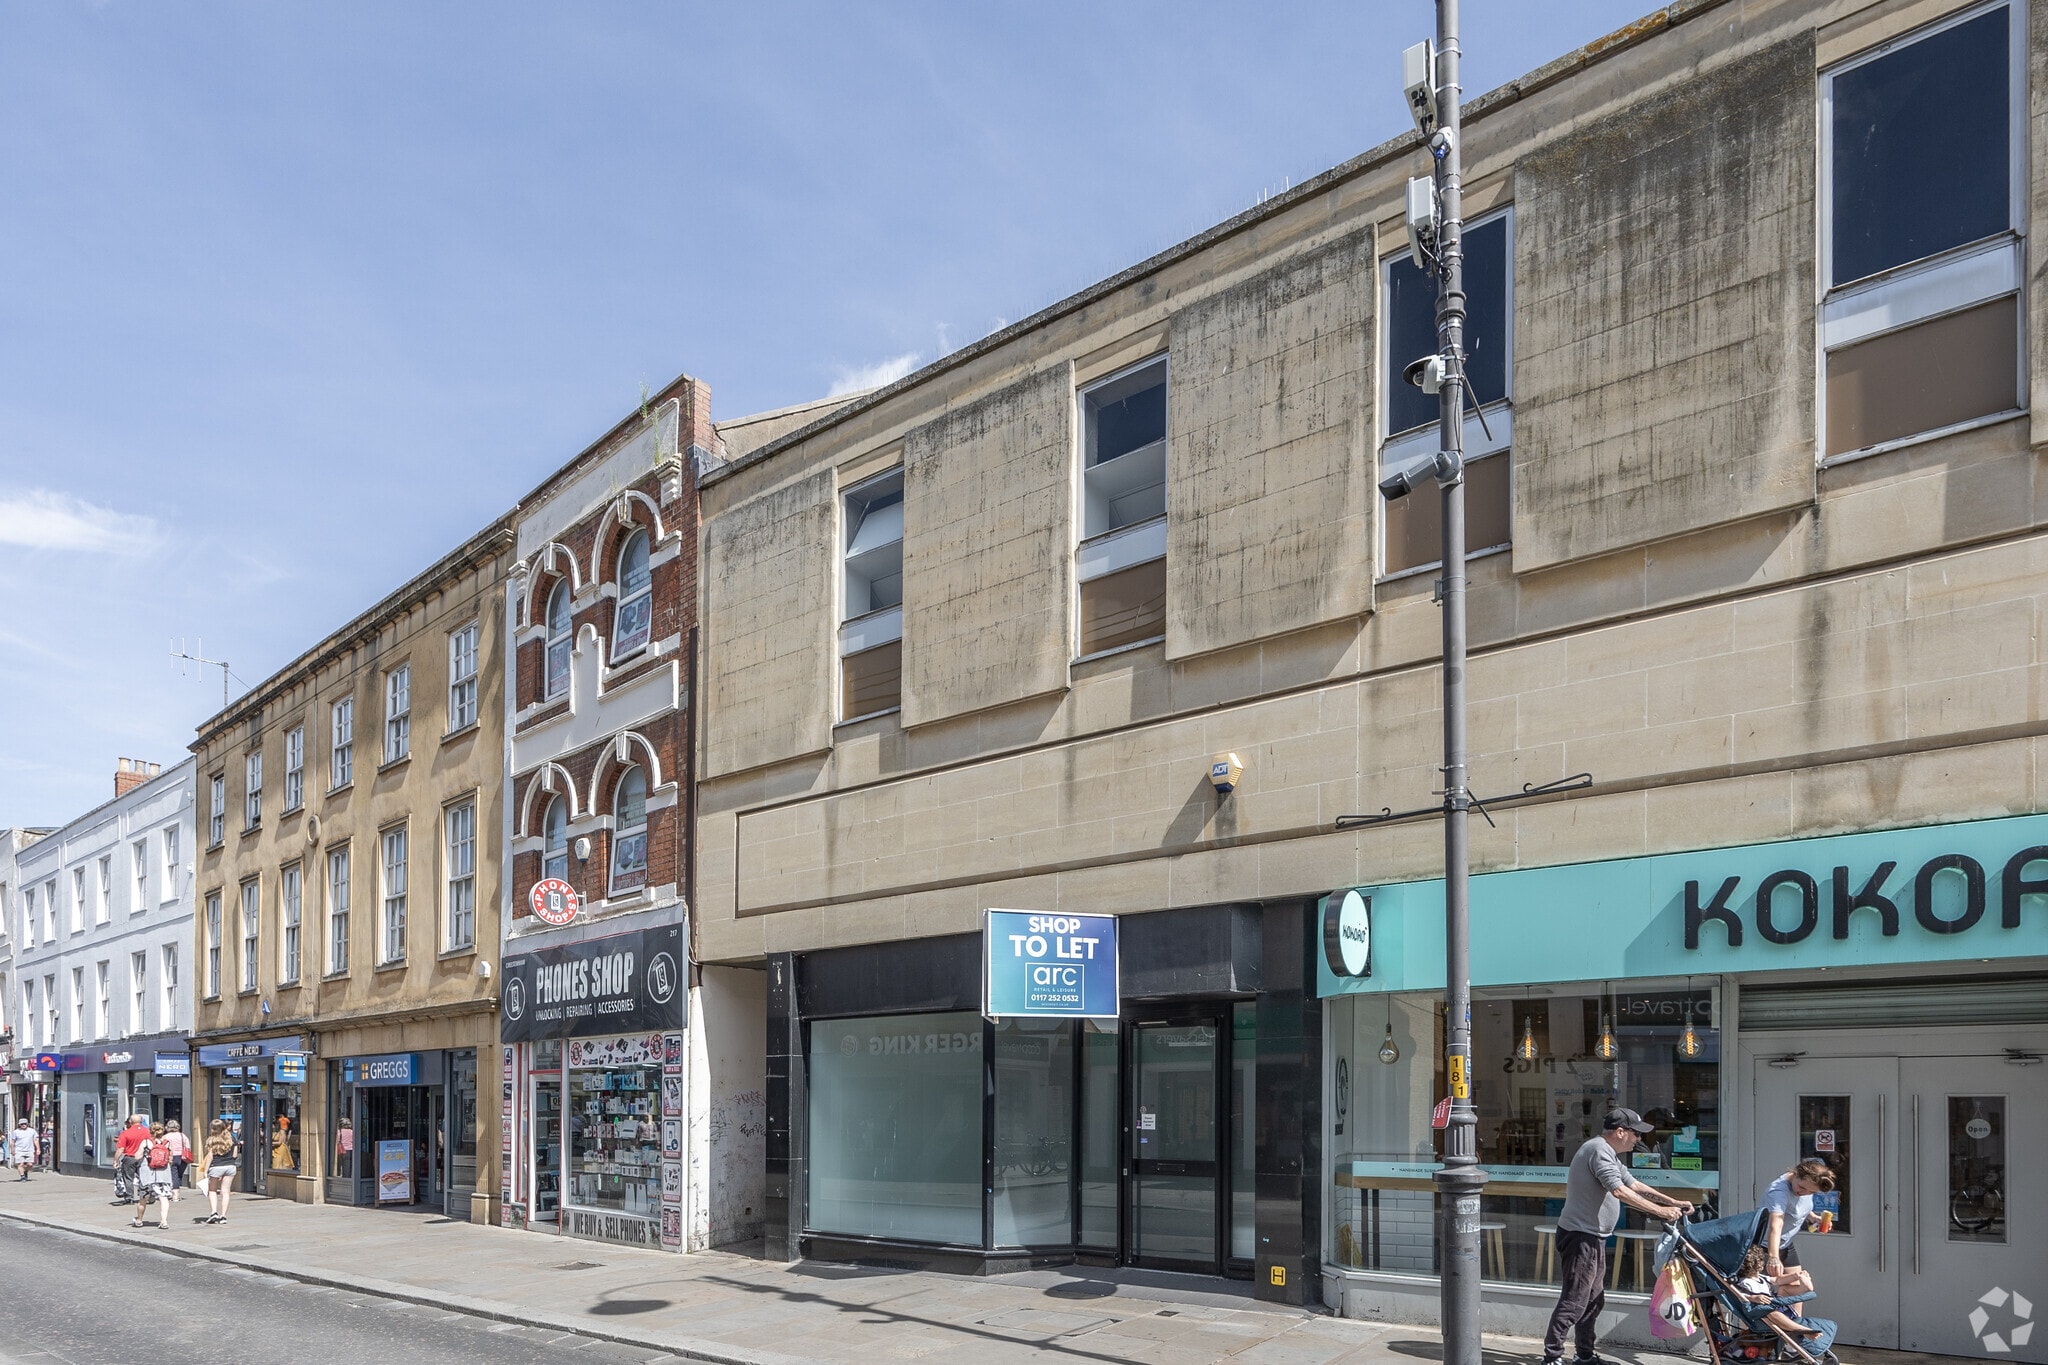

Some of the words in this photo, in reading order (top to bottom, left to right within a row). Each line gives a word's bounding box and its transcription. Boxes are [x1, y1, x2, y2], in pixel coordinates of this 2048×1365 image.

[1213, 764, 1228, 774] ADT
[535, 881, 577, 911] PHONES
[540, 907, 569, 923] SHOP
[1028, 916, 1081, 934] SHOP
[1008, 934, 1048, 958] TO
[1056, 936, 1099, 960] LET
[537, 958, 589, 1005] PHONES
[592, 951, 634, 998] SHOP
[1033, 966, 1077, 986] arc
[1047, 994, 1061, 1002] 252
[536, 1006, 561, 1021] UNLOCKING
[566, 1003, 592, 1018] REPAIRING
[597, 998, 635, 1014] ACCESSORIES
[370, 1060, 408, 1080] GREGGS
[1968, 1126, 1988, 1134] Open
[573, 1212, 583, 1234] WE
[585, 1213, 597, 1236] BUY
[598, 1218, 603, 1238] &
[605, 1215, 619, 1239] SELL
[620, 1218, 646, 1244] PHONES
[1272, 1268, 1284, 1283] H
[1665, 1302, 1686, 1320] JD
